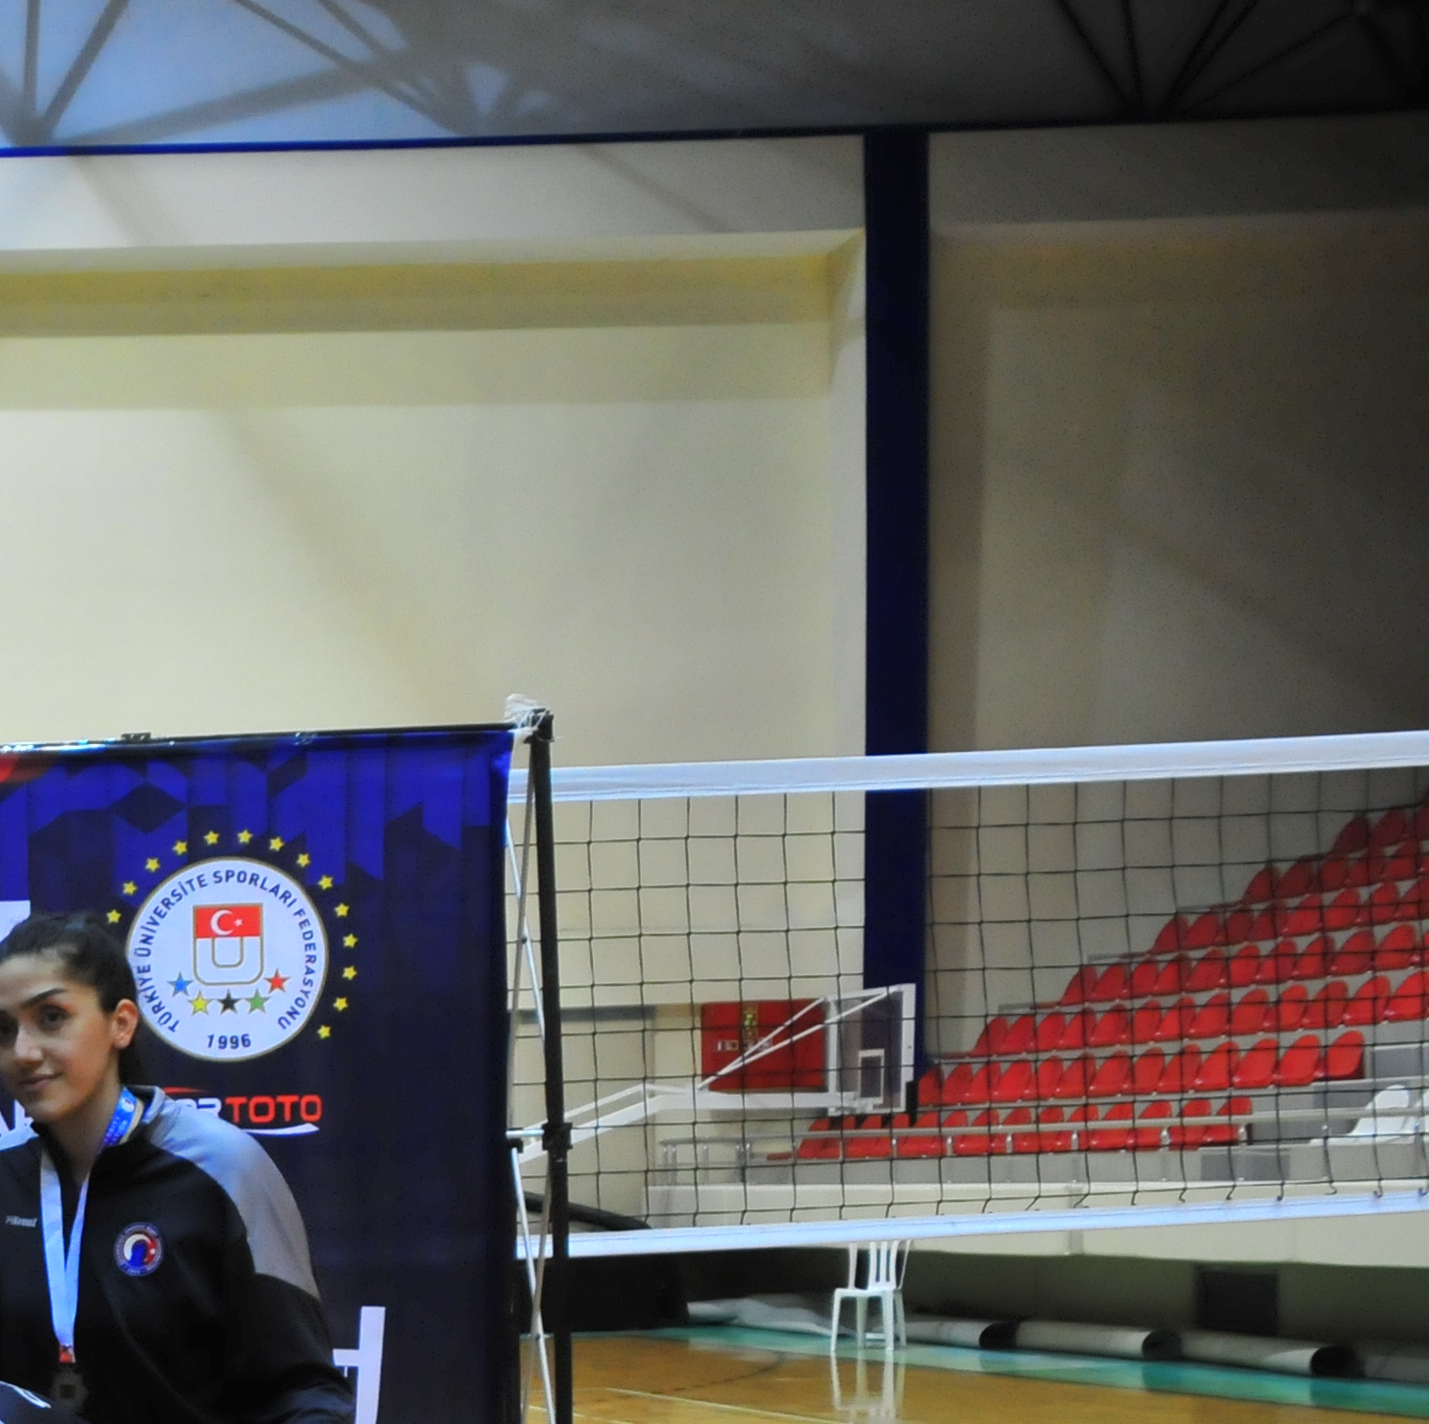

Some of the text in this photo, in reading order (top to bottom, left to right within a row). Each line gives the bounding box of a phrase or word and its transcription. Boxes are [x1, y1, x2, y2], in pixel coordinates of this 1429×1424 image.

[134, 869, 317, 1032] TÜRKİYE ÜNİVERSİTE SPORLARI FEDERASYONU
[207, 1033, 251, 1050] 1996
